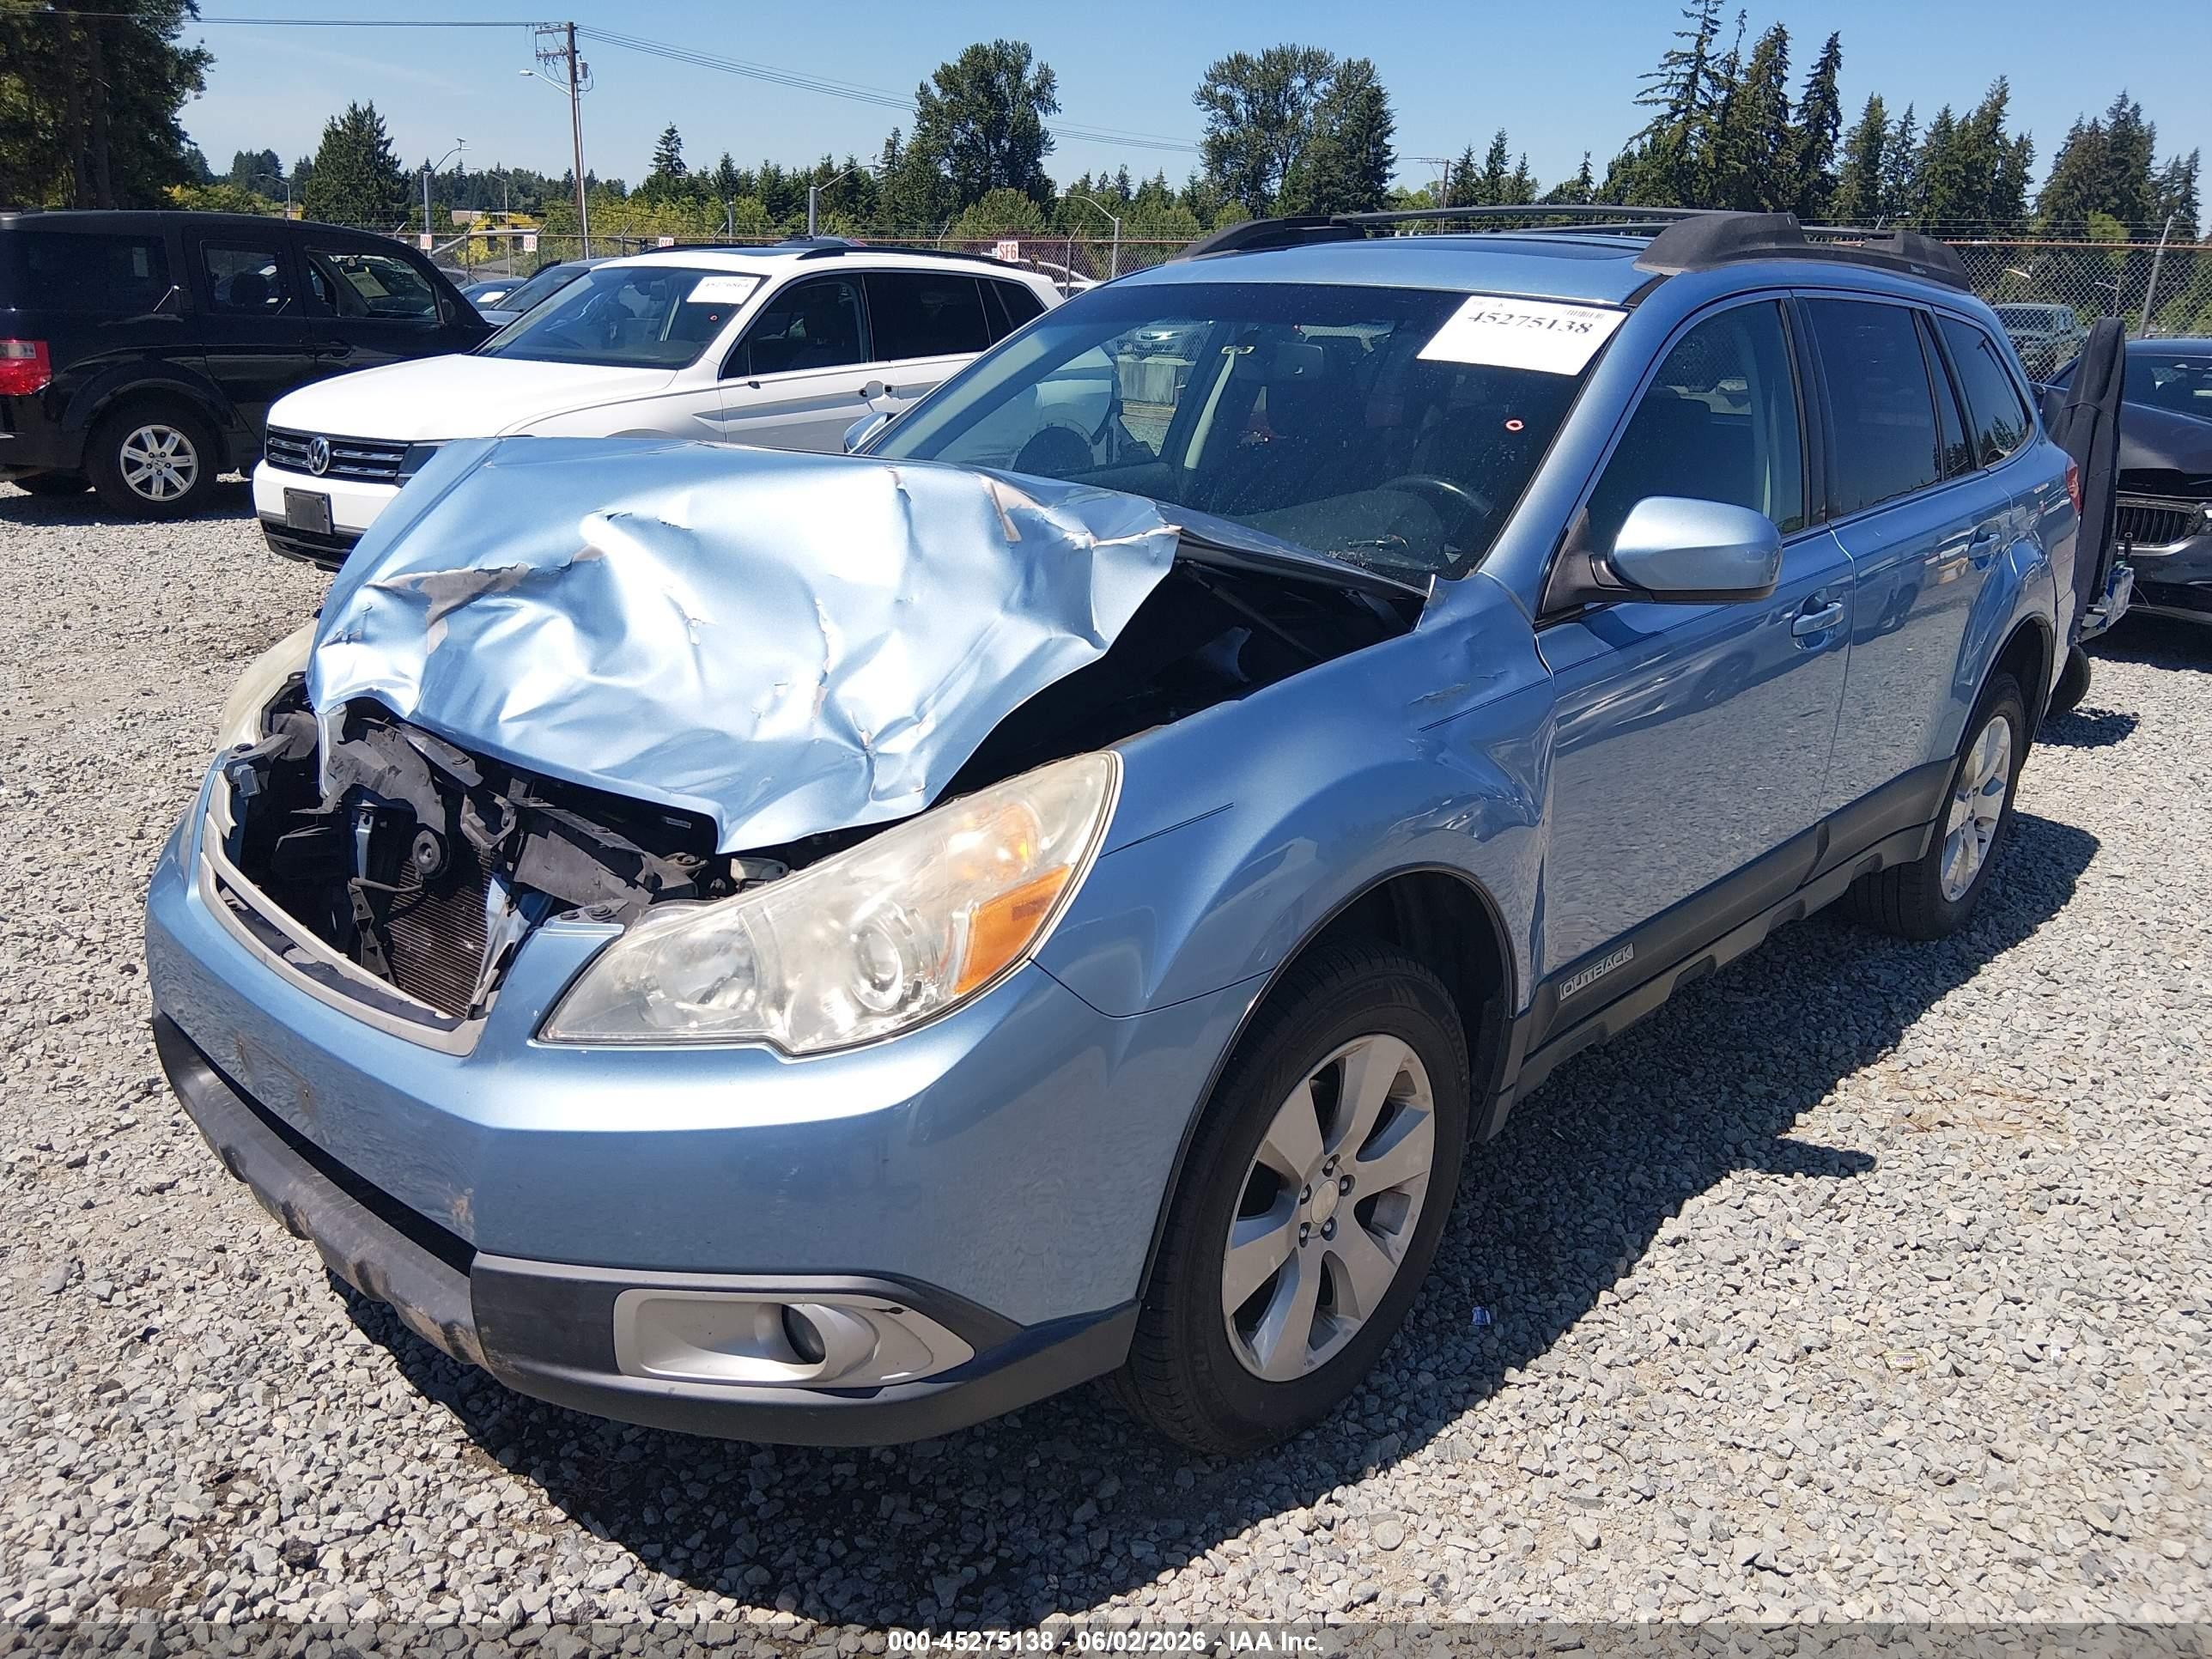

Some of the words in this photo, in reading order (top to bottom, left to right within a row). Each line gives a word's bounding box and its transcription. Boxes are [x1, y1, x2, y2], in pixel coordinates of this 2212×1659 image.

[525, 236, 536, 249] SF9
[999, 244, 1017, 260] SF6
[1468, 311, 1594, 334] 45275138
[1560, 943, 1634, 1001] OUTBACK
